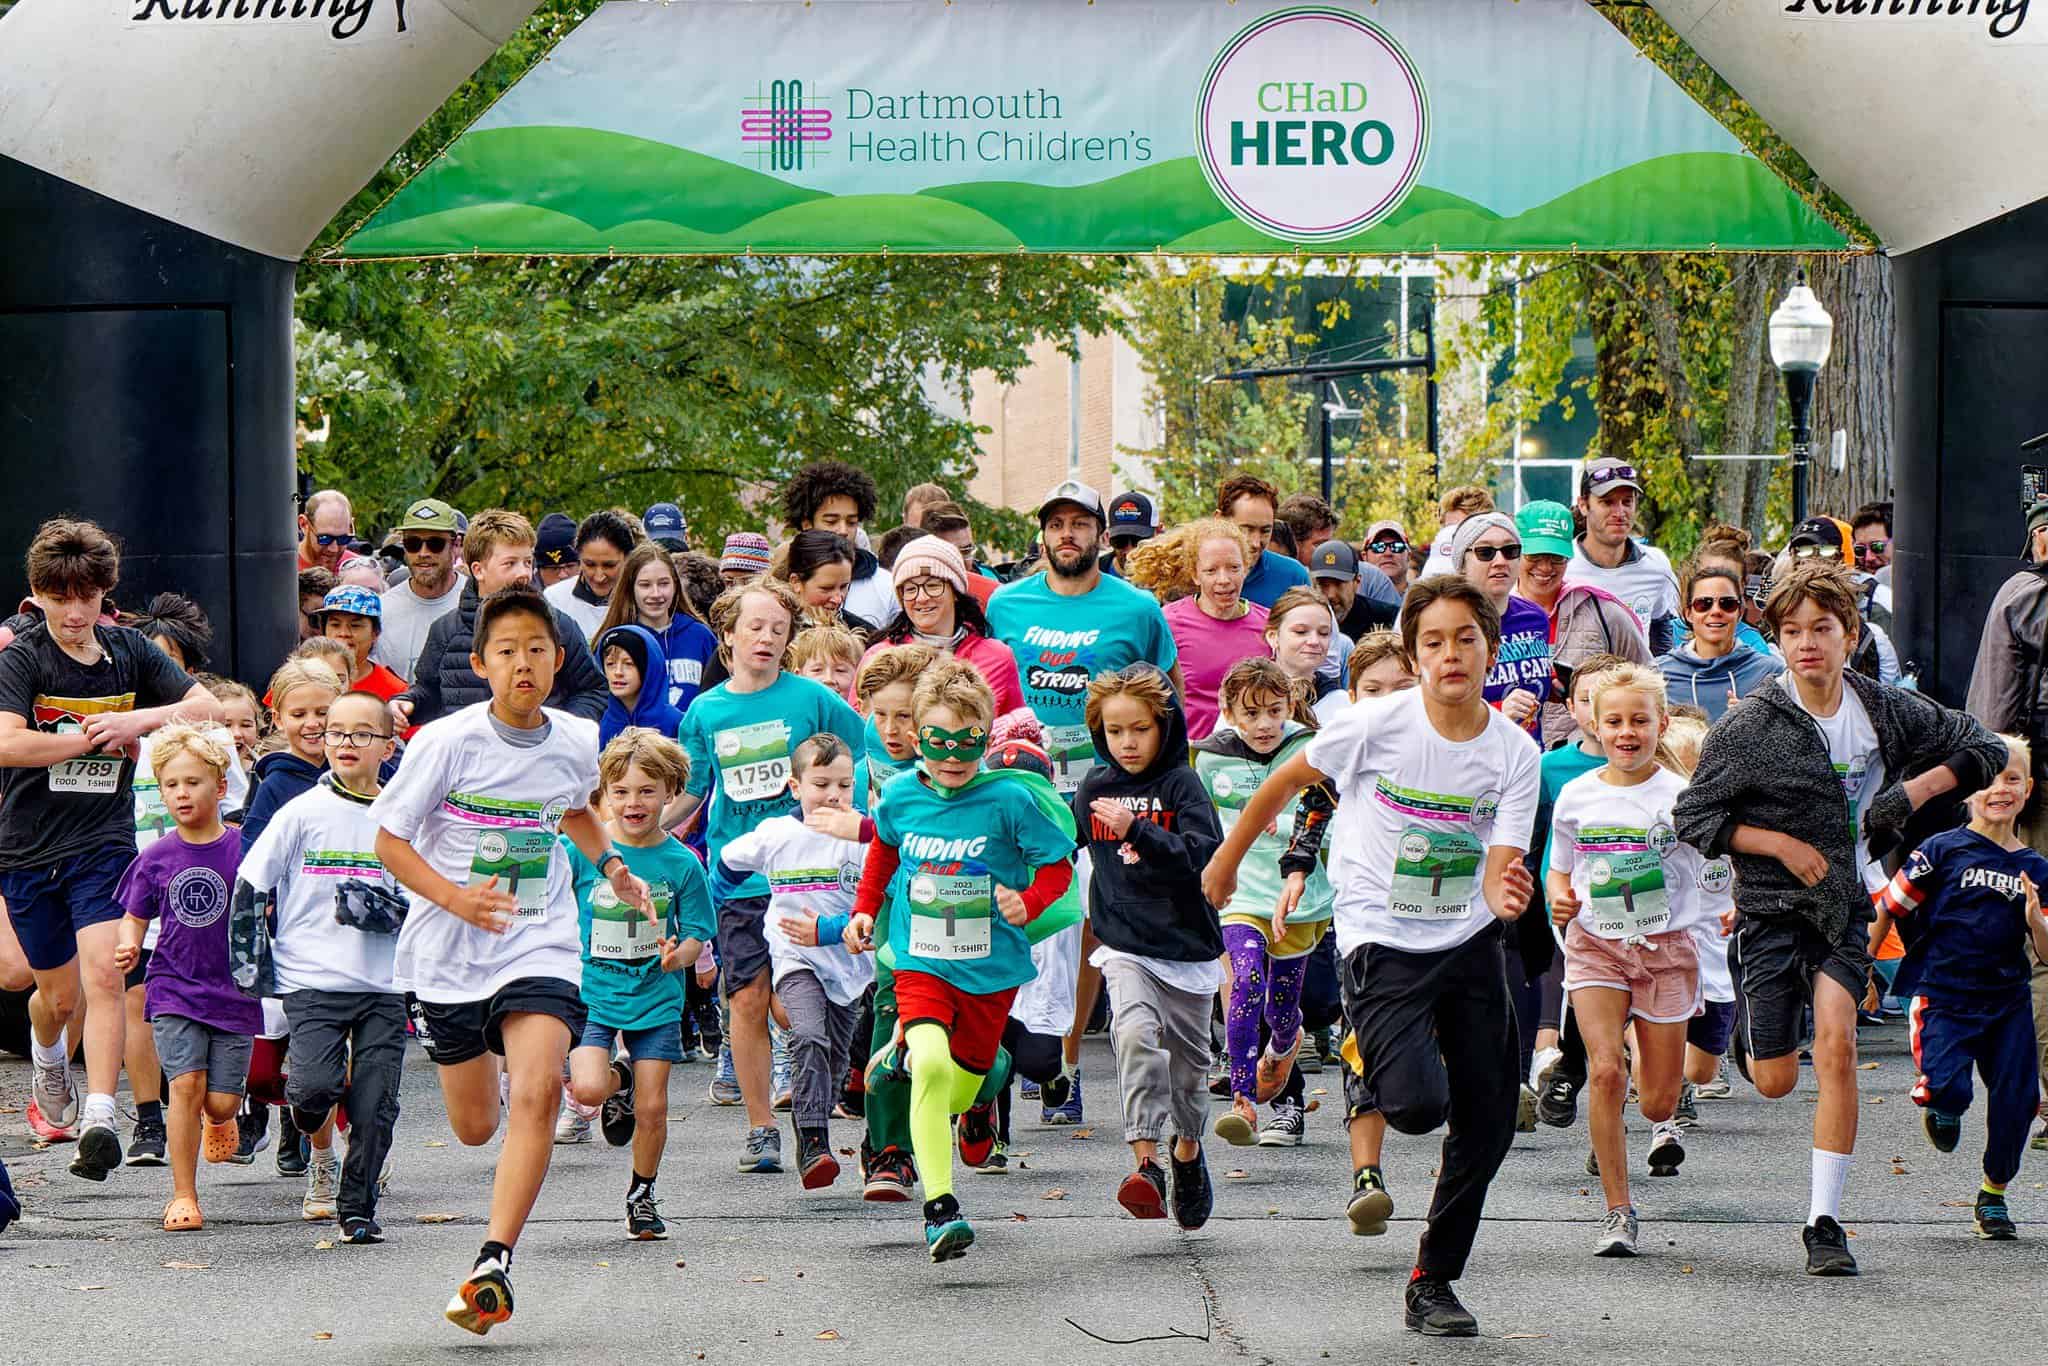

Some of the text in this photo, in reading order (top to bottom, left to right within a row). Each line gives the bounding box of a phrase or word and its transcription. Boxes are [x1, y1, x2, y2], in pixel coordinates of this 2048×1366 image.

[846, 88, 1063, 120] Dartmouth
[1257, 81, 1368, 112] CHaD
[848, 130, 1153, 162] Health Children's
[1230, 119, 1395, 166] HERO
[1022, 625, 1100, 650] FINDING
[1040, 650, 1077, 667] OUR
[1029, 670, 1088, 689] STRIDE
[1485, 657, 1551, 687] EAR CAP
[64, 761, 113, 777] 1789
[733, 761, 784, 787] 1750
[55, 778, 116, 788] FOOD T-SHIRT
[1151, 797, 1163, 811] A
[482, 846, 502, 854] HERO
[902, 831, 988, 861] FINDING
[1405, 846, 1425, 854] HERO
[1613, 866, 1633, 874] Cams
[1633, 861, 1660, 871] Course
[1704, 869, 1728, 882] HERO
[953, 881, 973, 889] 2023
[1429, 864, 1443, 897] 1
[1960, 867, 2026, 895] PATRIO
[939, 888, 961, 897] Cams
[962, 888, 991, 897] Course
[1619, 883, 1636, 913] 1
[518, 907, 546, 917] SHIRT
[1392, 902, 1423, 914] FOOD
[624, 909, 638, 938] 1
[942, 904, 956, 937] 1
[1600, 912, 1669, 932] FOOD T-SHIRT
[596, 944, 623, 953] FOOD
[914, 942, 989, 954] FOOD T-SHIRT
